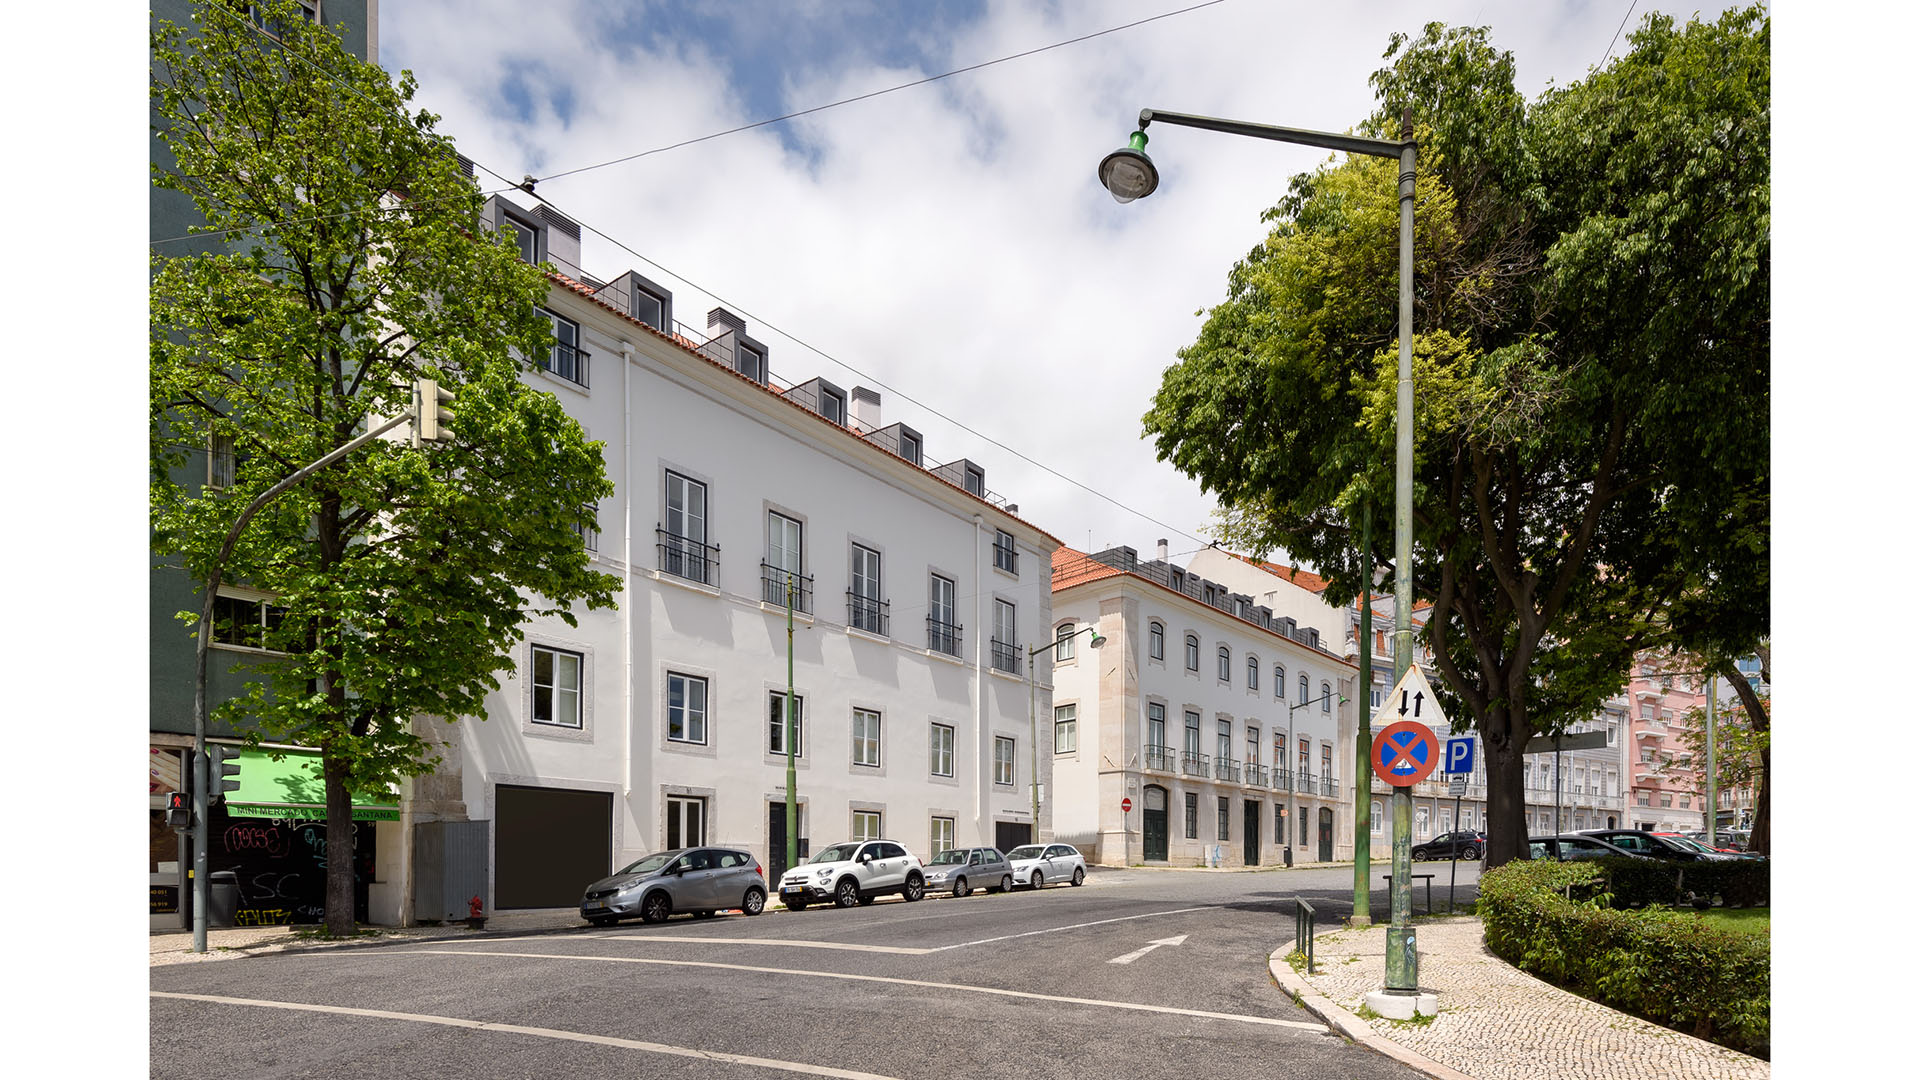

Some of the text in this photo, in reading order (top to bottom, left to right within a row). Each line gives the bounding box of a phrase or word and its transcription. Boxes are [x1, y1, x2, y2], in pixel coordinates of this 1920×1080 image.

[1450, 742, 1468, 771] P
[237, 807, 258, 815] MINI
[260, 808, 308, 817] MERCADO
[312, 809, 327, 818] CA
